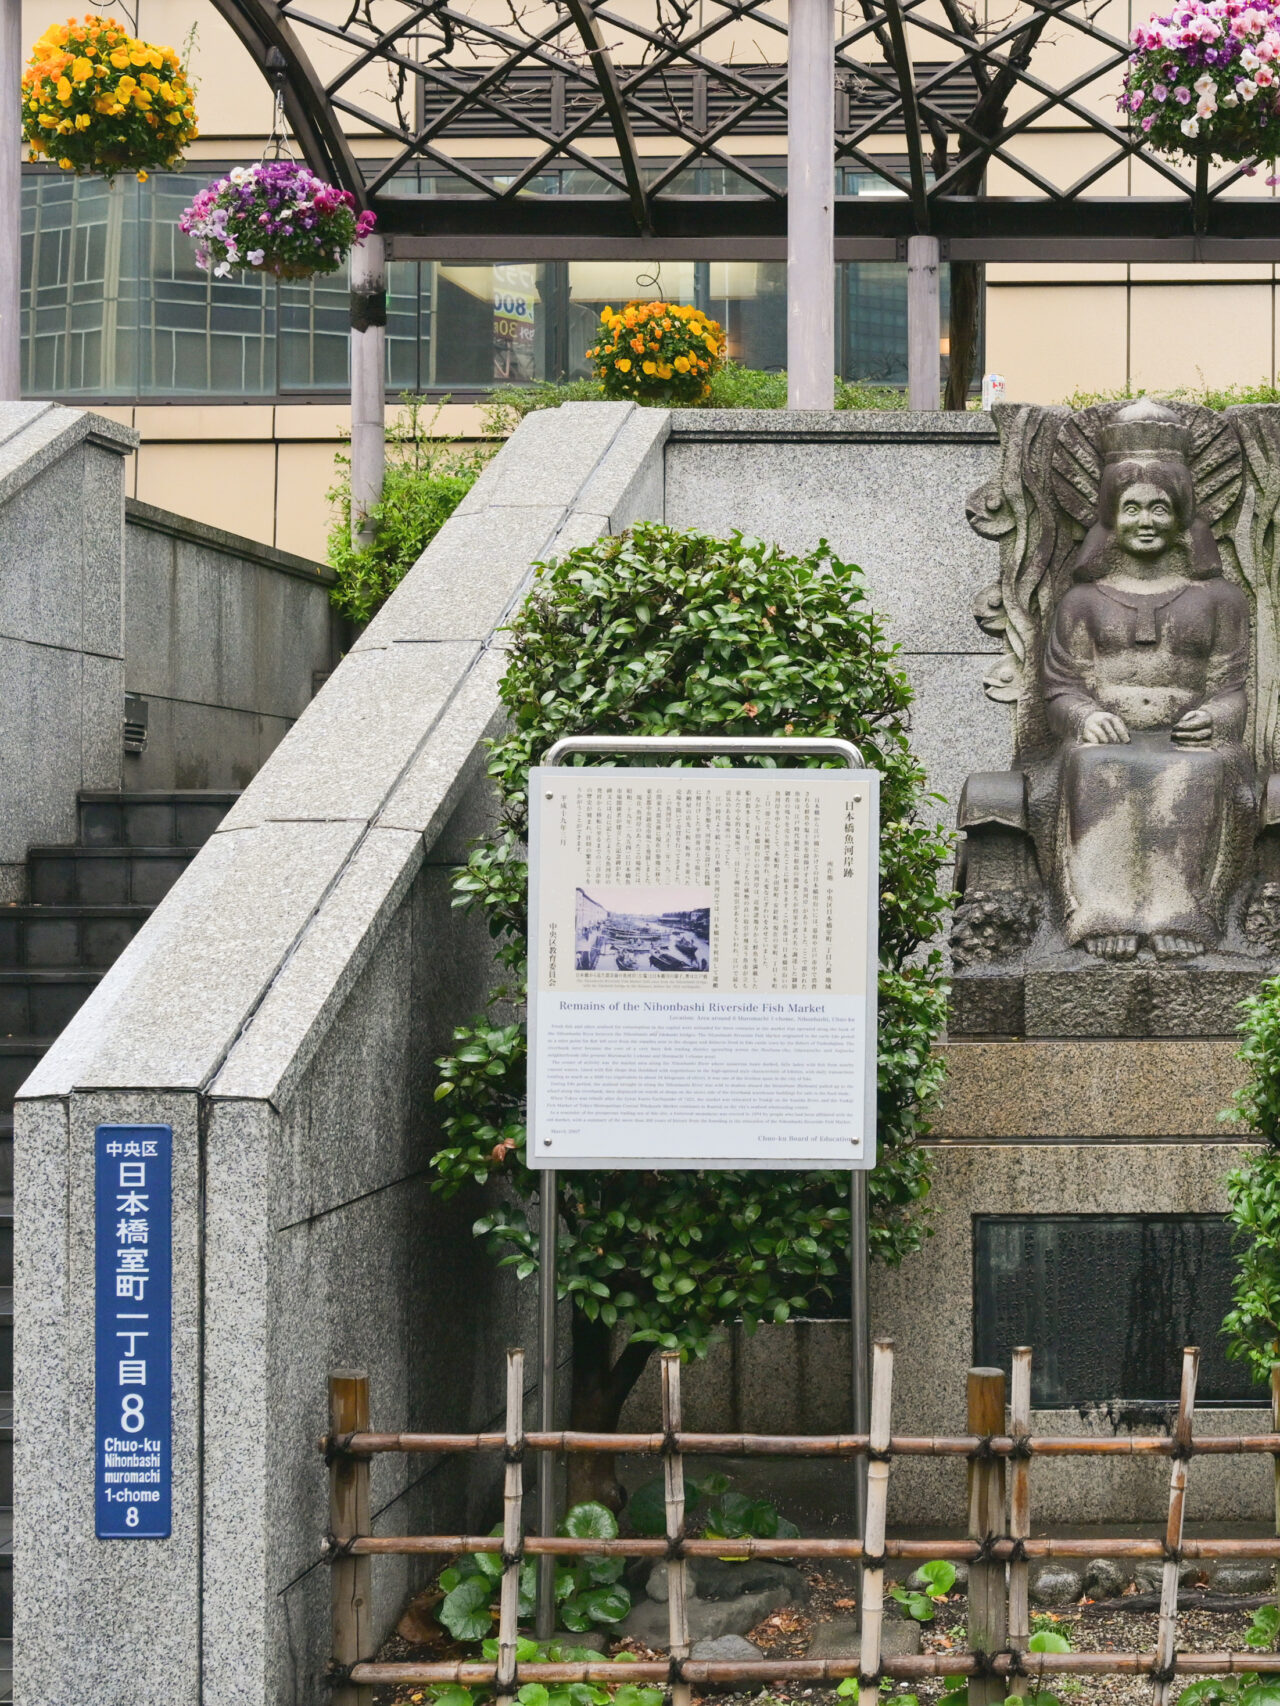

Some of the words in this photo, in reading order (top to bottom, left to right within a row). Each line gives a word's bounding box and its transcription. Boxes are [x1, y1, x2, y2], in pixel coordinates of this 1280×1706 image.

[843, 800, 856, 879] 日本橋魚河岸跡
[548, 922, 558, 987] 中央区教育委員会
[559, 1001, 605, 1011] Remains
[609, 1001, 620, 1011] of
[623, 1001, 640, 1011] the
[643, 1002, 705, 1012] Nihonbashi
[709, 1002, 758, 1012] Riverside
[762, 1003, 784, 1013] Fish
[788, 1003, 825, 1013] Market
[106, 1140, 158, 1158] 中央区
[104, 1438, 161, 1452] Chuo-ku
[104, 1454, 160, 1468] Nihonbashi
[104, 1469, 161, 1484] muromachi
[105, 1488, 160, 1502] 1-chome
[125, 1506, 139, 1528] 8
